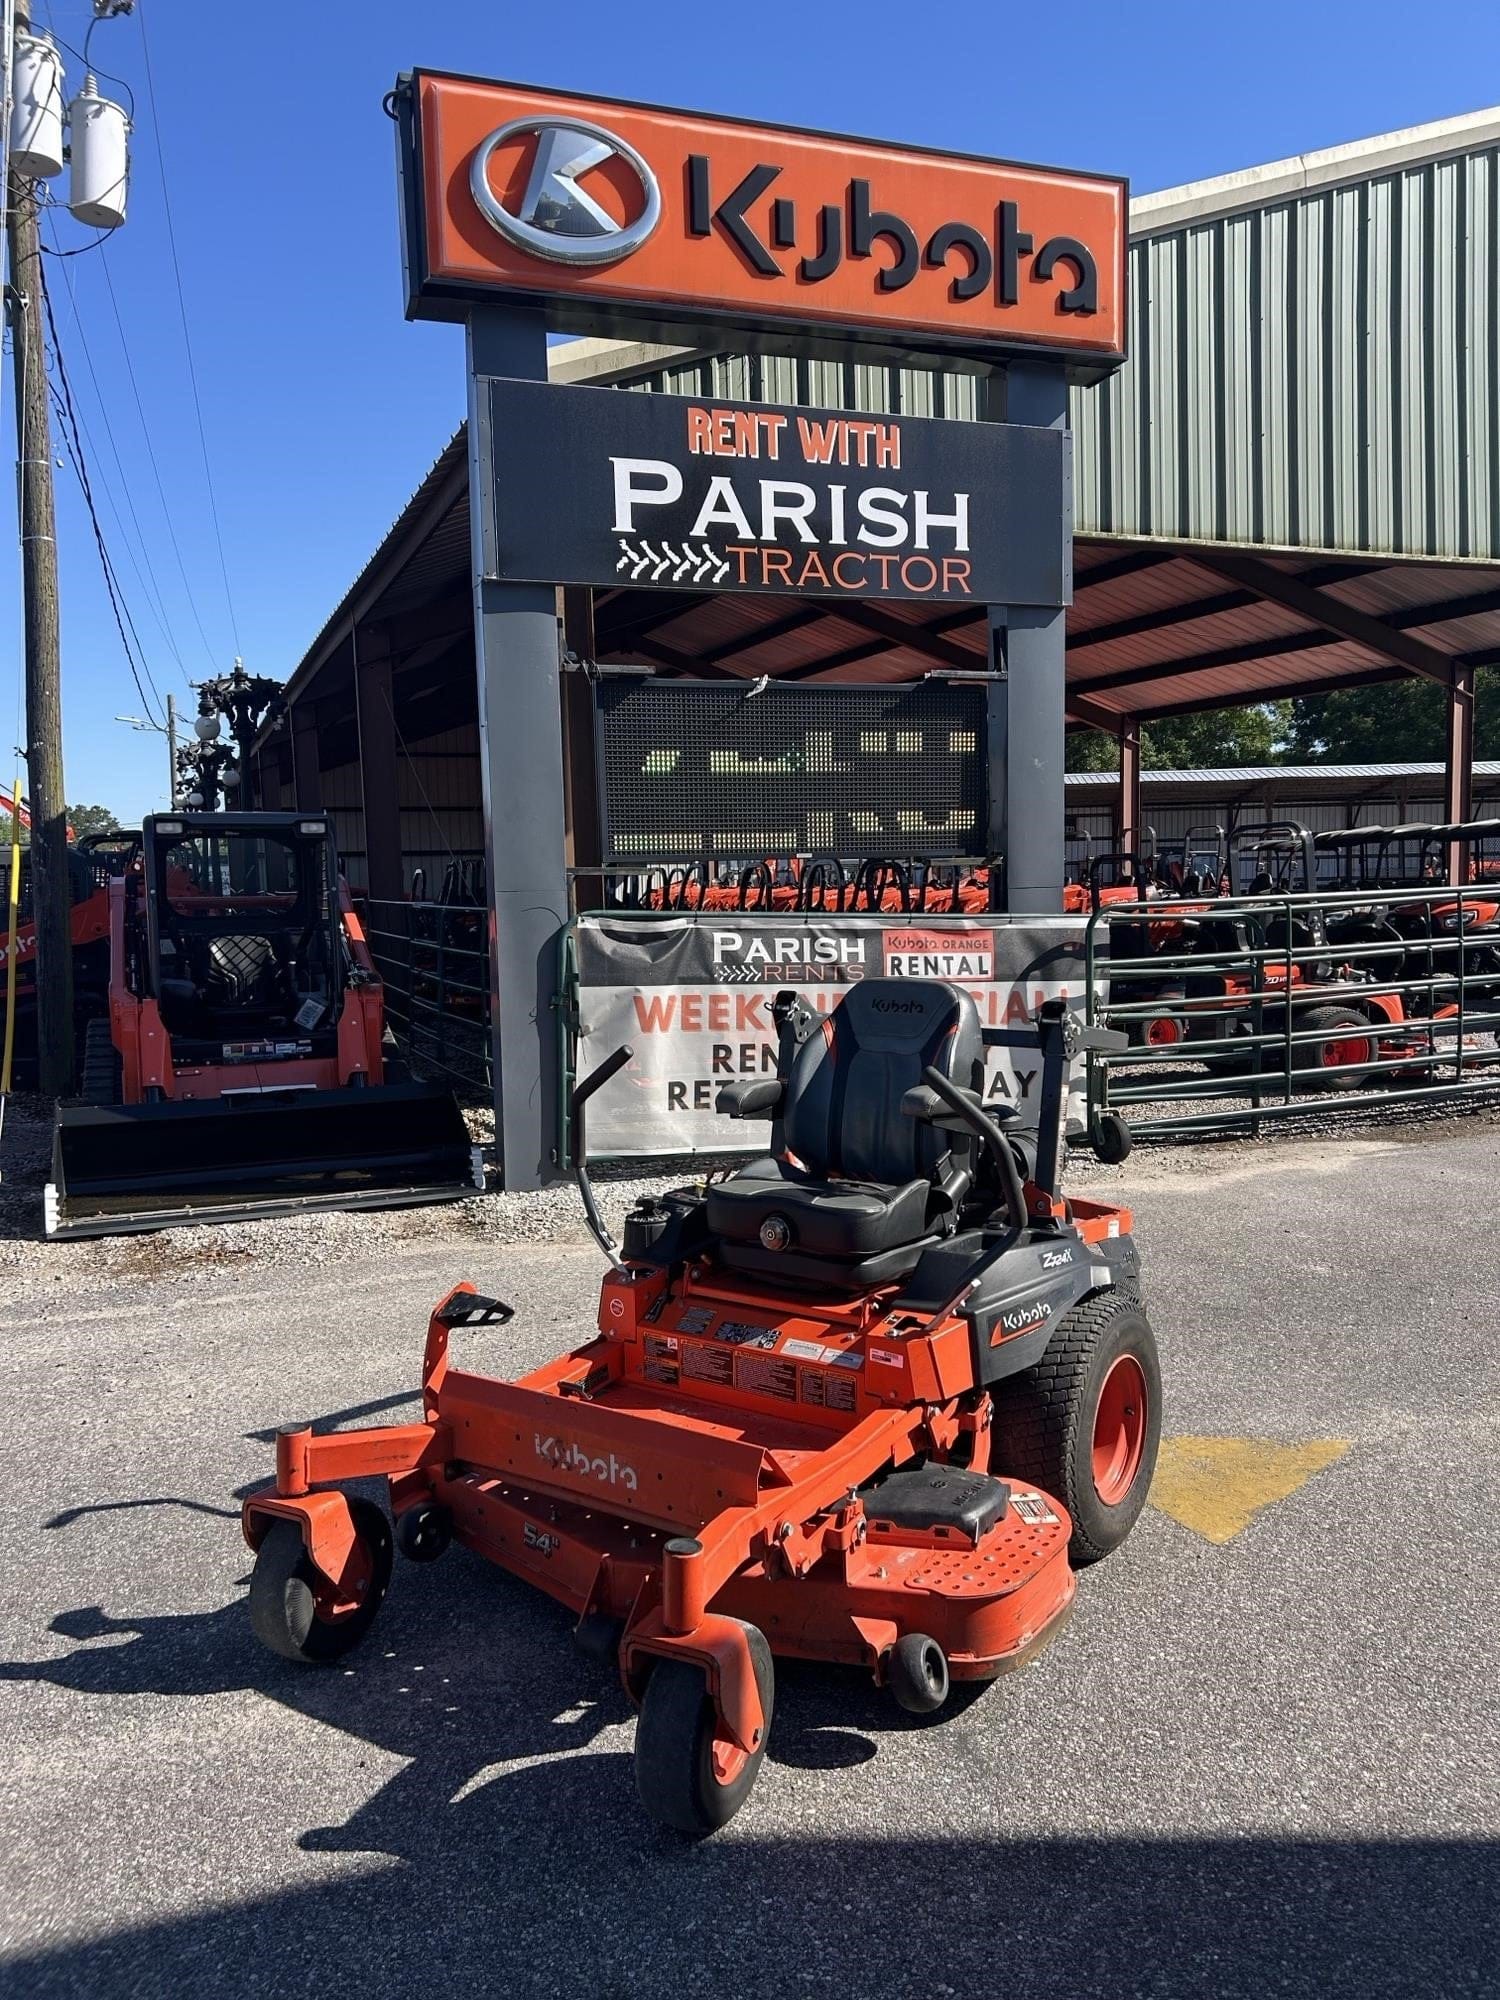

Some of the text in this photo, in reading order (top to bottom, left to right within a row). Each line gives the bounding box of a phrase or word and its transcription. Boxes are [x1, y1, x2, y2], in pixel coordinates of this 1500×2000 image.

[687, 153, 1098, 315] Kubota
[687, 407, 901, 470] RENT WITH
[608, 456, 970, 551] PARISH
[726, 544, 972, 594] TRACTOR
[712, 932, 867, 963] PARISH
[888, 936, 989, 950] Kubota ORANGE
[764, 963, 866, 982] RENTS
[890, 955, 990, 976] RENTAL
[871, 998, 924, 1014] Kubota
[1003, 1301, 1052, 1330] Kubota
[534, 1432, 638, 1491] Kubota
